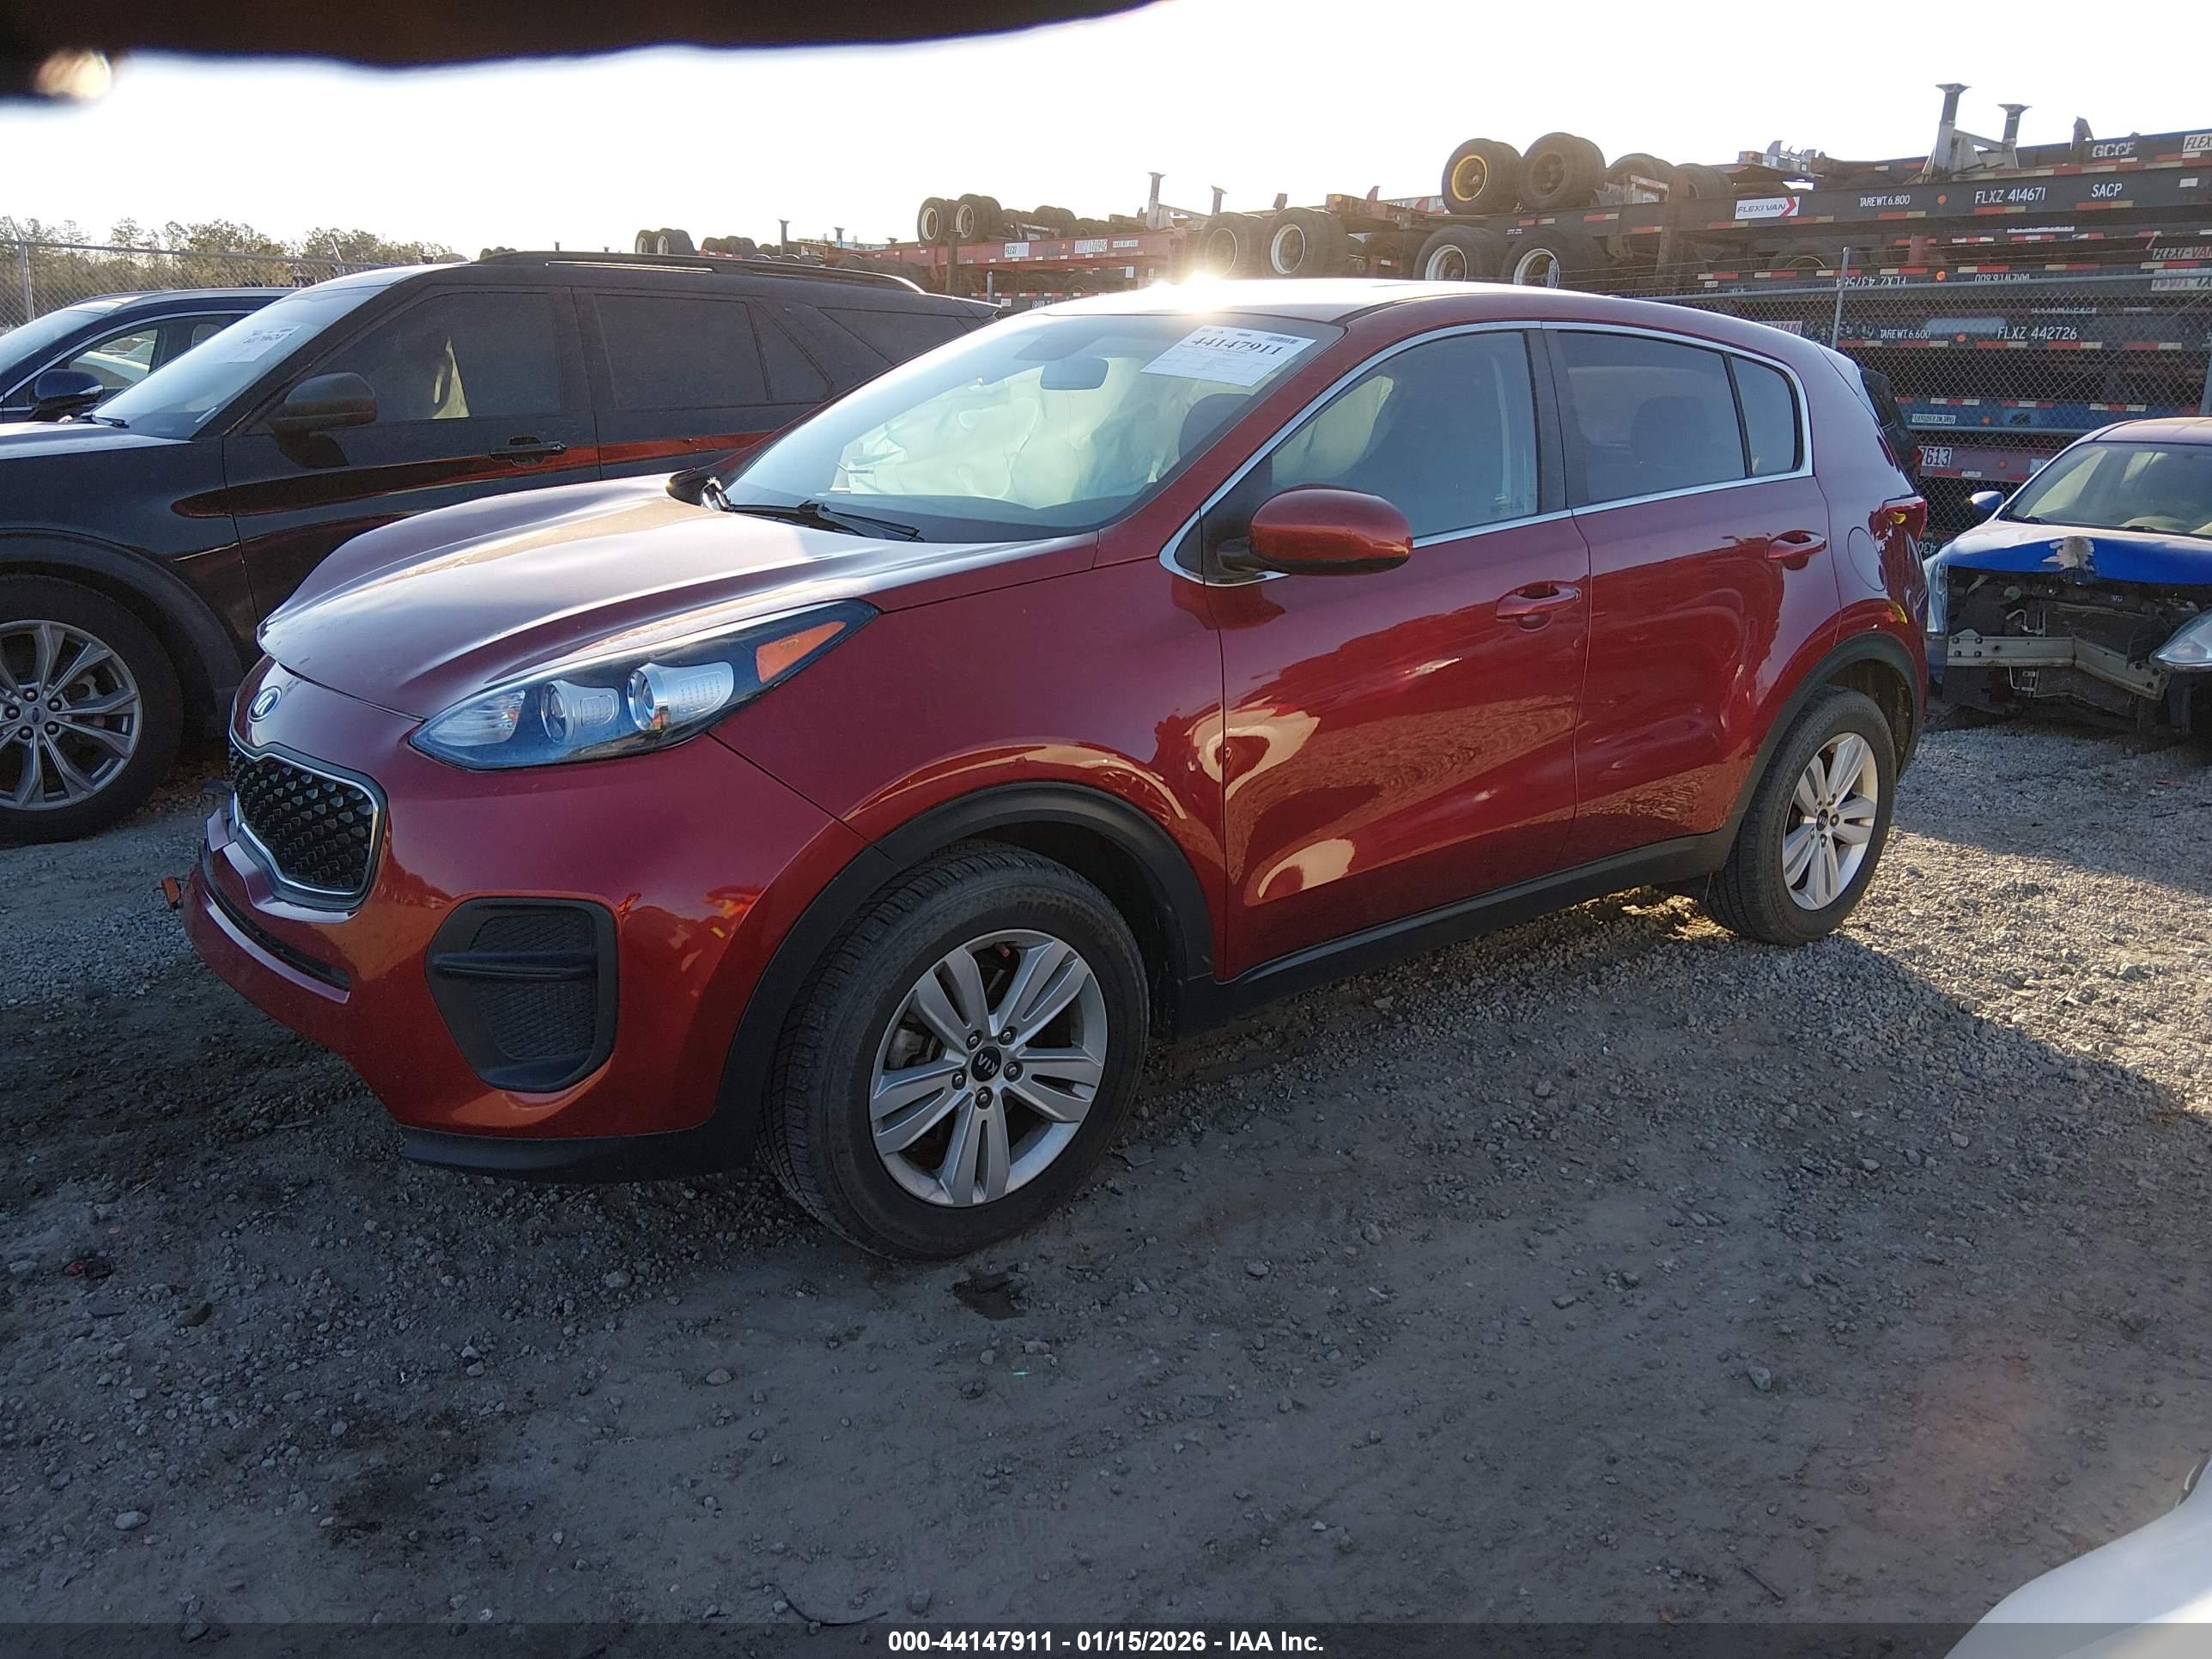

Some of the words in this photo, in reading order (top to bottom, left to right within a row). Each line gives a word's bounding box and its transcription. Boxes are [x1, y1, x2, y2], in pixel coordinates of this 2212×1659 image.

[1975, 190, 2003, 204] FLXZ
[2007, 186, 2046, 204] 414671
[2091, 182, 2123, 198] SACP
[1765, 204, 1786, 212] VAN
[1997, 326, 2027, 340] FLXZ
[2030, 326, 2078, 340] 442726
[1192, 336, 1284, 356] 44147911
[978, 1053, 998, 1075] KIA
